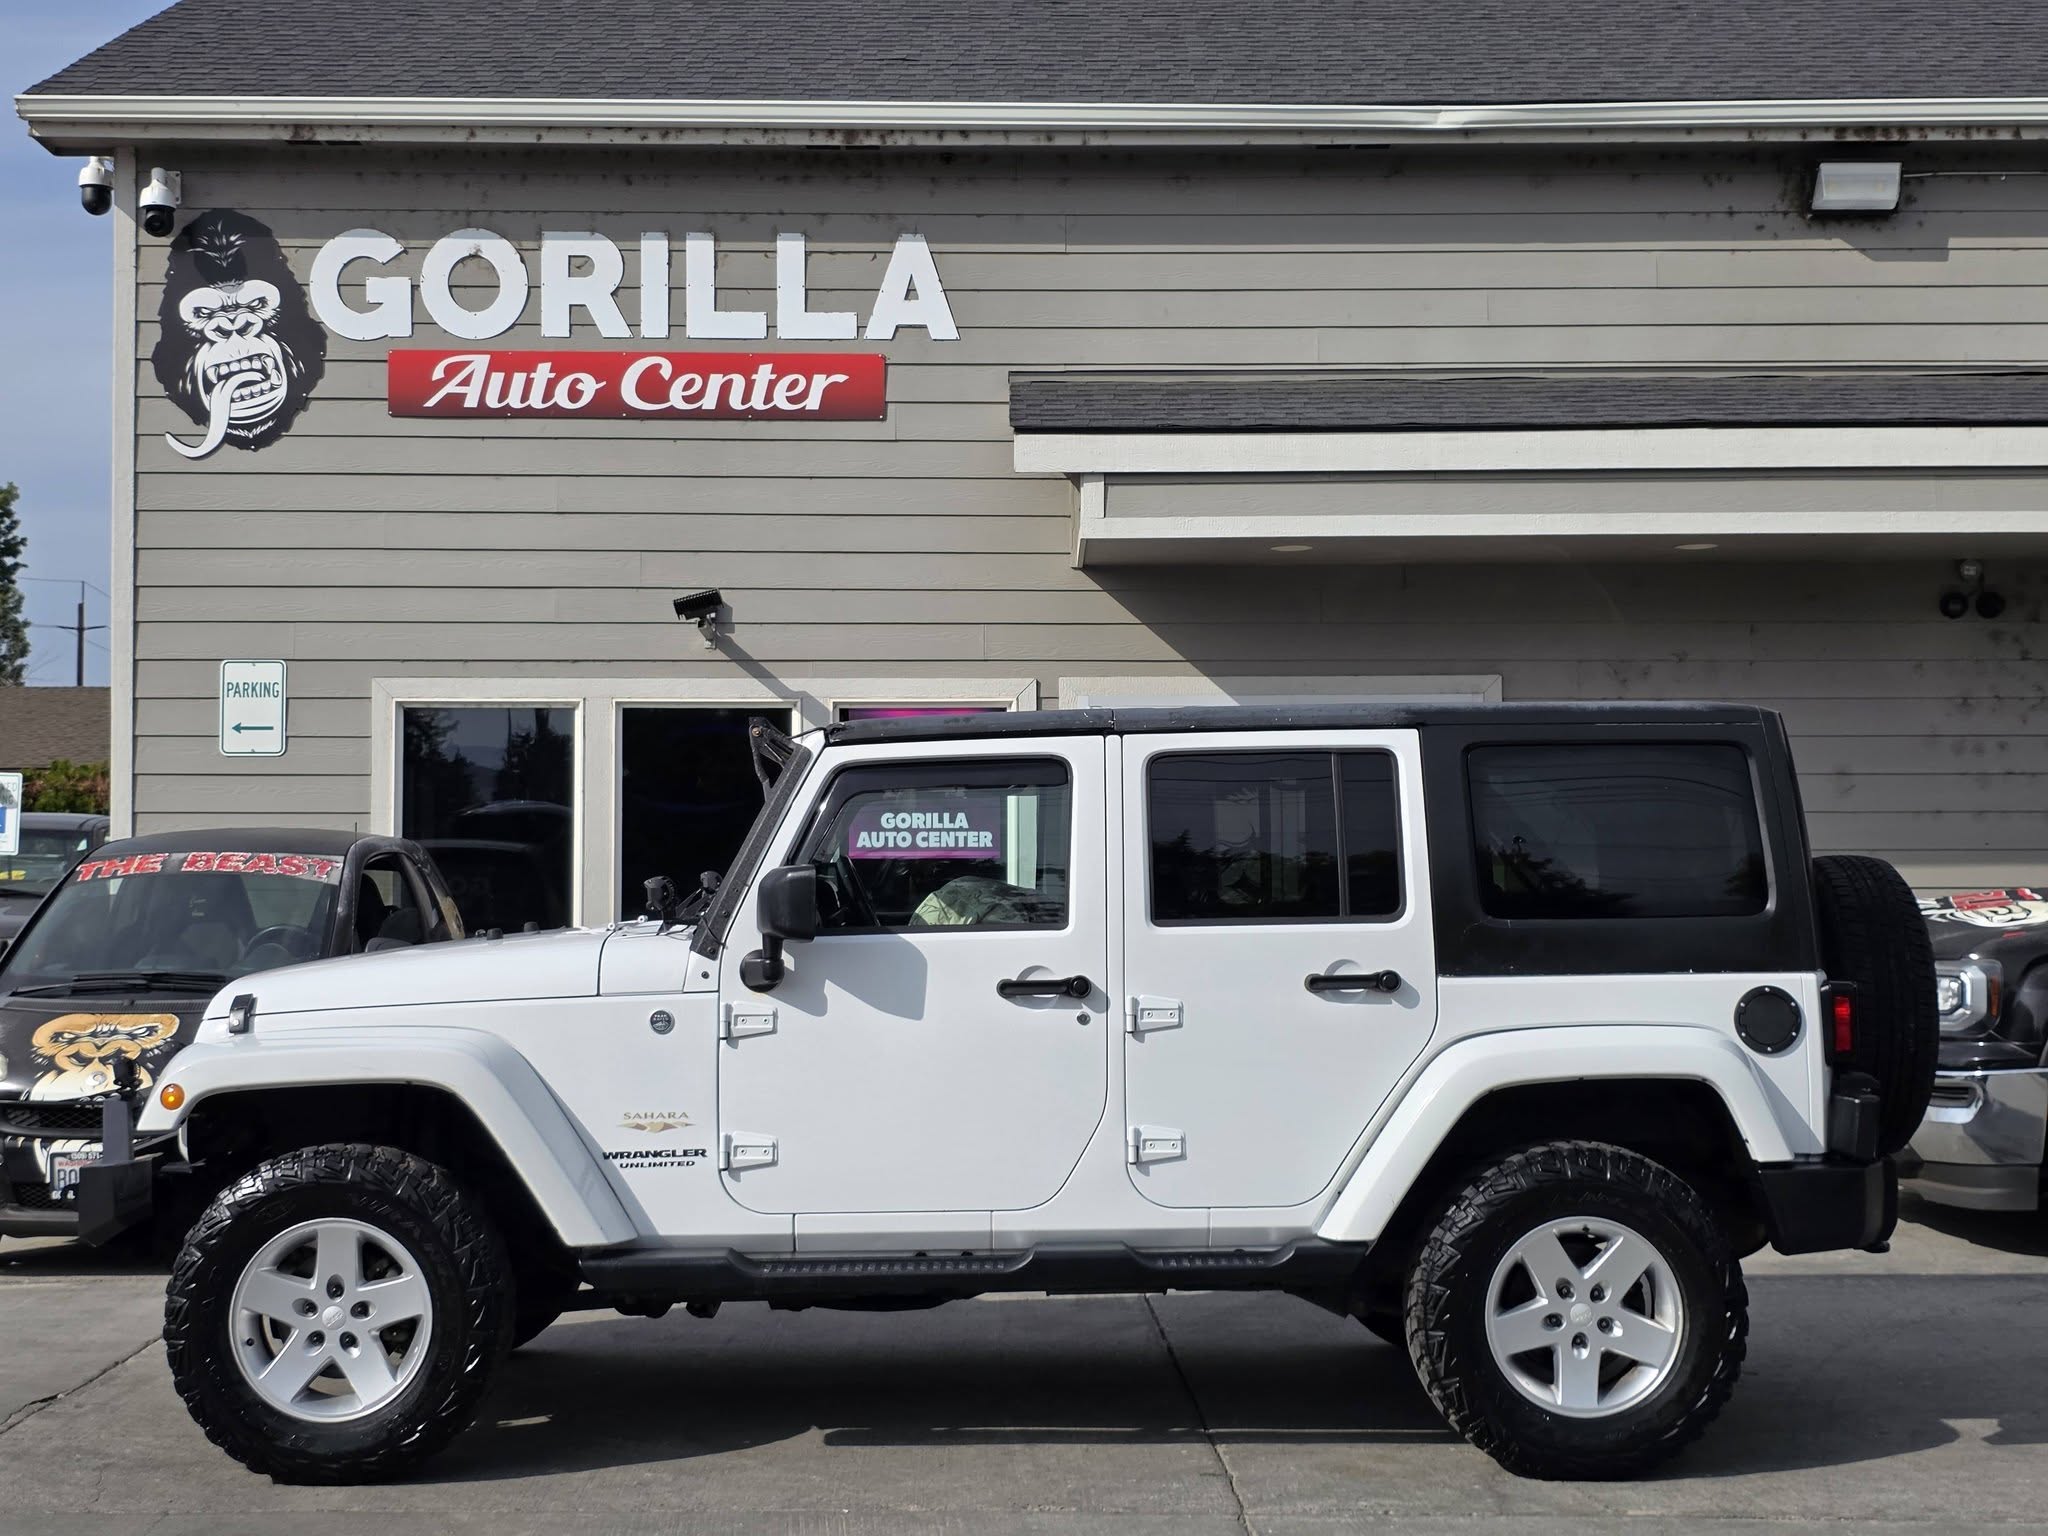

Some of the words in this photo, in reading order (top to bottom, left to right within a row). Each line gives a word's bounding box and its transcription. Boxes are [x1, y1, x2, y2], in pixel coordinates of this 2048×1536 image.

[309, 228, 960, 341] GORILLA
[423, 354, 606, 411] Auto
[620, 355, 849, 412] Center
[226, 681, 280, 699] PARKING
[880, 812, 969, 829] GORILLA
[856, 831, 912, 848] AUTO
[916, 831, 993, 848] CENTER
[77, 852, 169, 881] THE
[181, 851, 343, 879] BEAST
[623, 1111, 689, 1120] SAHARA
[602, 1148, 707, 1160] WRANGLER
[619, 1160, 695, 1169] UNLIMITED
